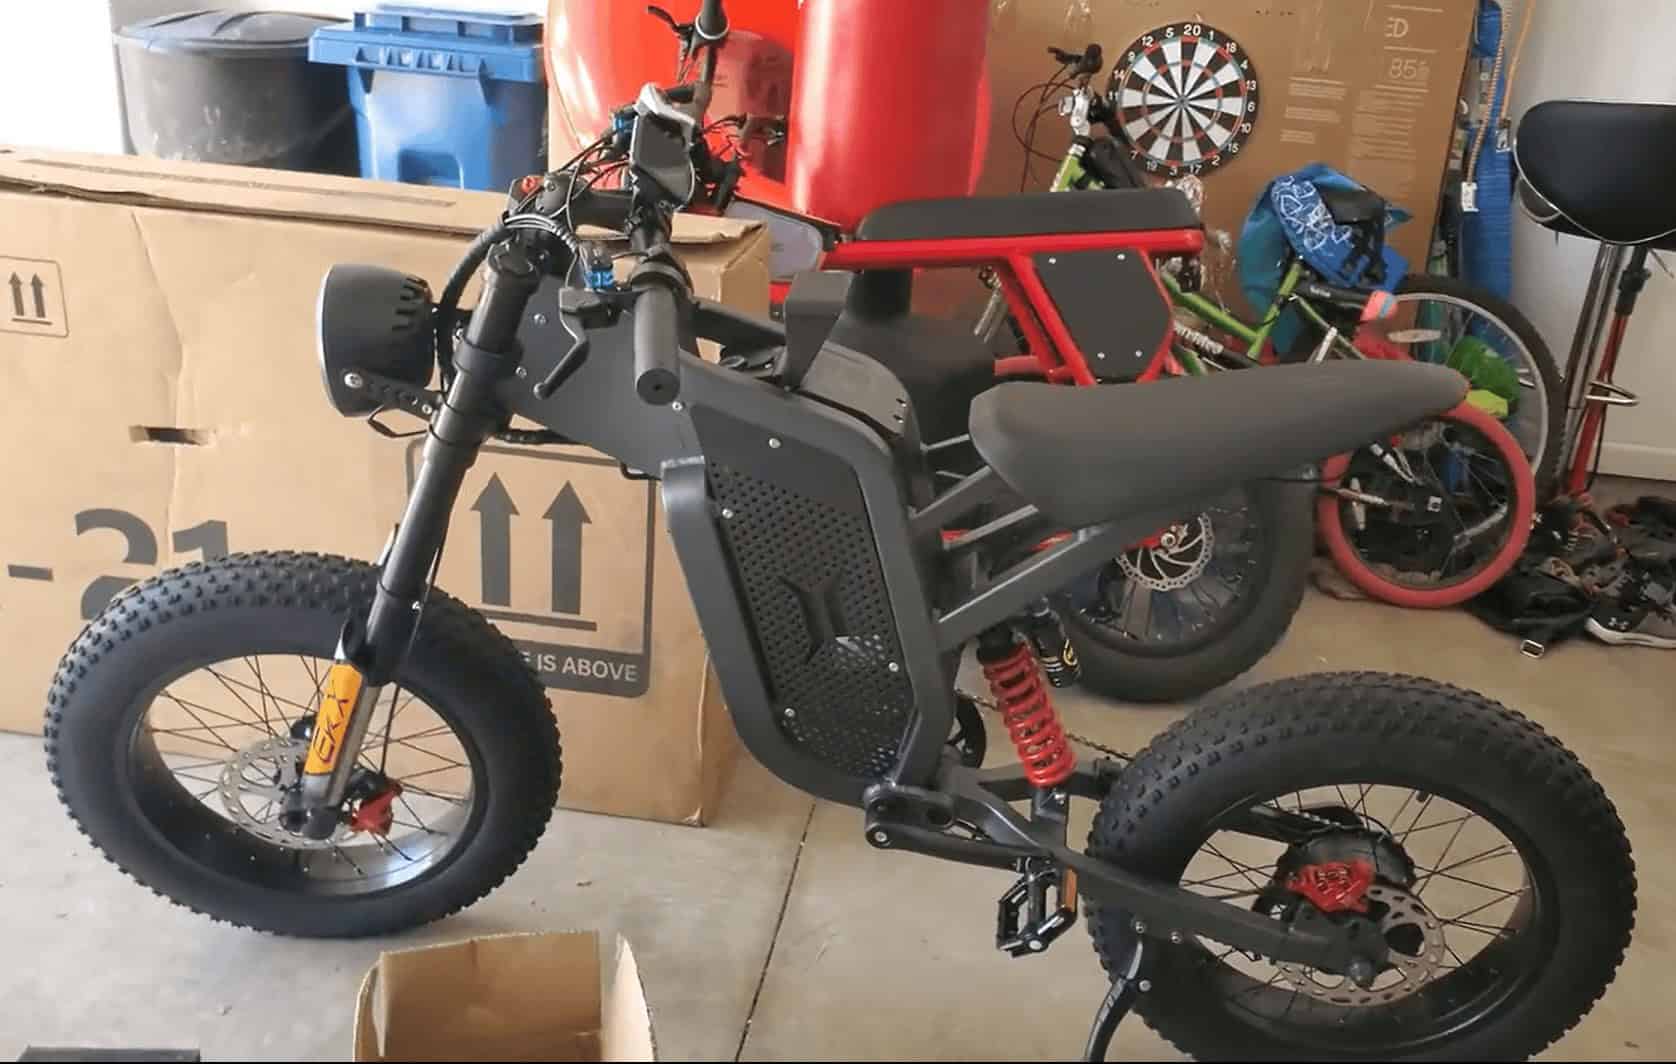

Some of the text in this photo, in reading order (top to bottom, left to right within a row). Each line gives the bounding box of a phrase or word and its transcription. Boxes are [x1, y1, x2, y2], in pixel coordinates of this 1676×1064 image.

[1165, 27, 1174, 38] 5
[1183, 24, 1201, 36] 20
[1208, 30, 1214, 40] 1
[1141, 35, 1154, 48] 12
[1128, 51, 1136, 62] 9
[1240, 59, 1249, 70] 4
[1246, 80, 1257, 91] 13
[1247, 101, 1255, 112] 6
[1240, 122, 1252, 133] 10
[1227, 142, 1239, 153] 15
[1211, 154, 1221, 166] 2
[1169, 165, 1178, 176] 3
[1189, 163, 1202, 174] 17
[537, 653, 557, 672] IS
[562, 656, 638, 682] ABOVE
